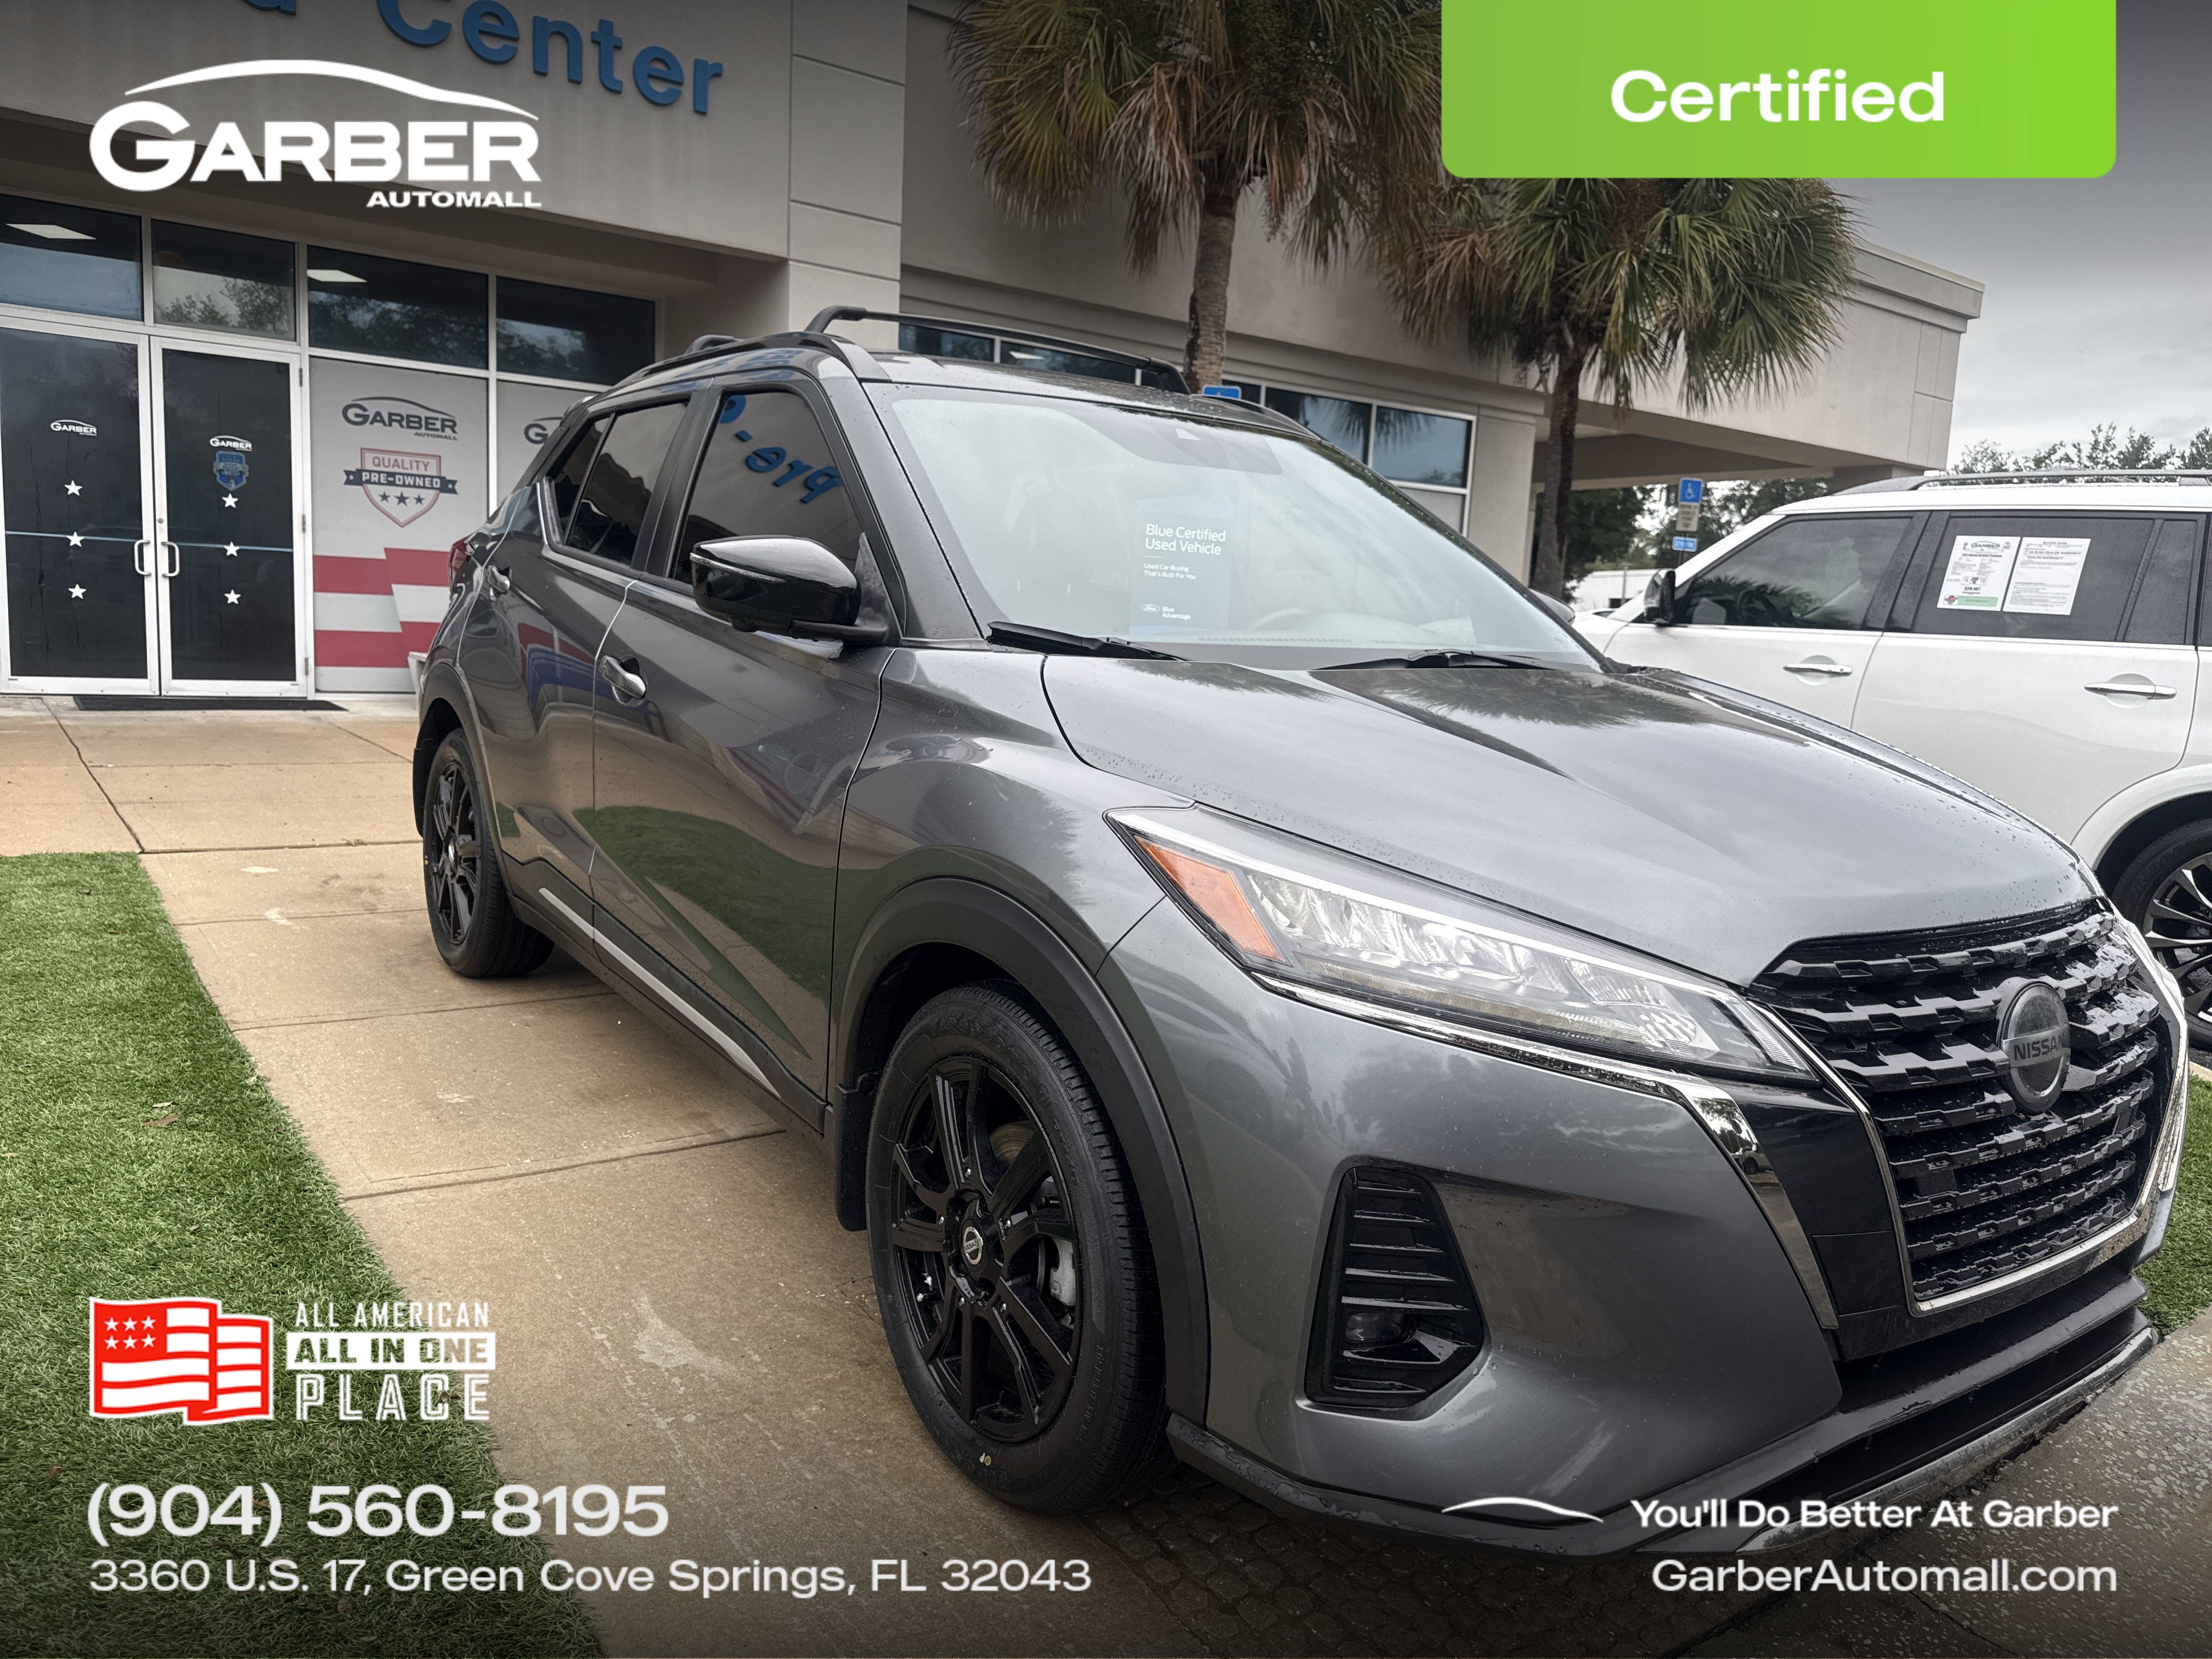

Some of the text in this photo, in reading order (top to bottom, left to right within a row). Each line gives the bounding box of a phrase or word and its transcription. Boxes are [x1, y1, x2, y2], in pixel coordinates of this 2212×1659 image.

[376, 0, 723, 114] Center
[342, 403, 458, 435] GARBER
[50, 422, 97, 434] GARBER
[210, 437, 252, 450] GARBER
[372, 456, 430, 471] QUALITY
[362, 471, 441, 488] PRE-OWNED
[1146, 523, 1226, 542] Blue Certified
[1145, 538, 1222, 555] Used Vehicle
[1170, 565, 1189, 573] Buying
[2013, 1032, 2068, 1061] NISSAN
